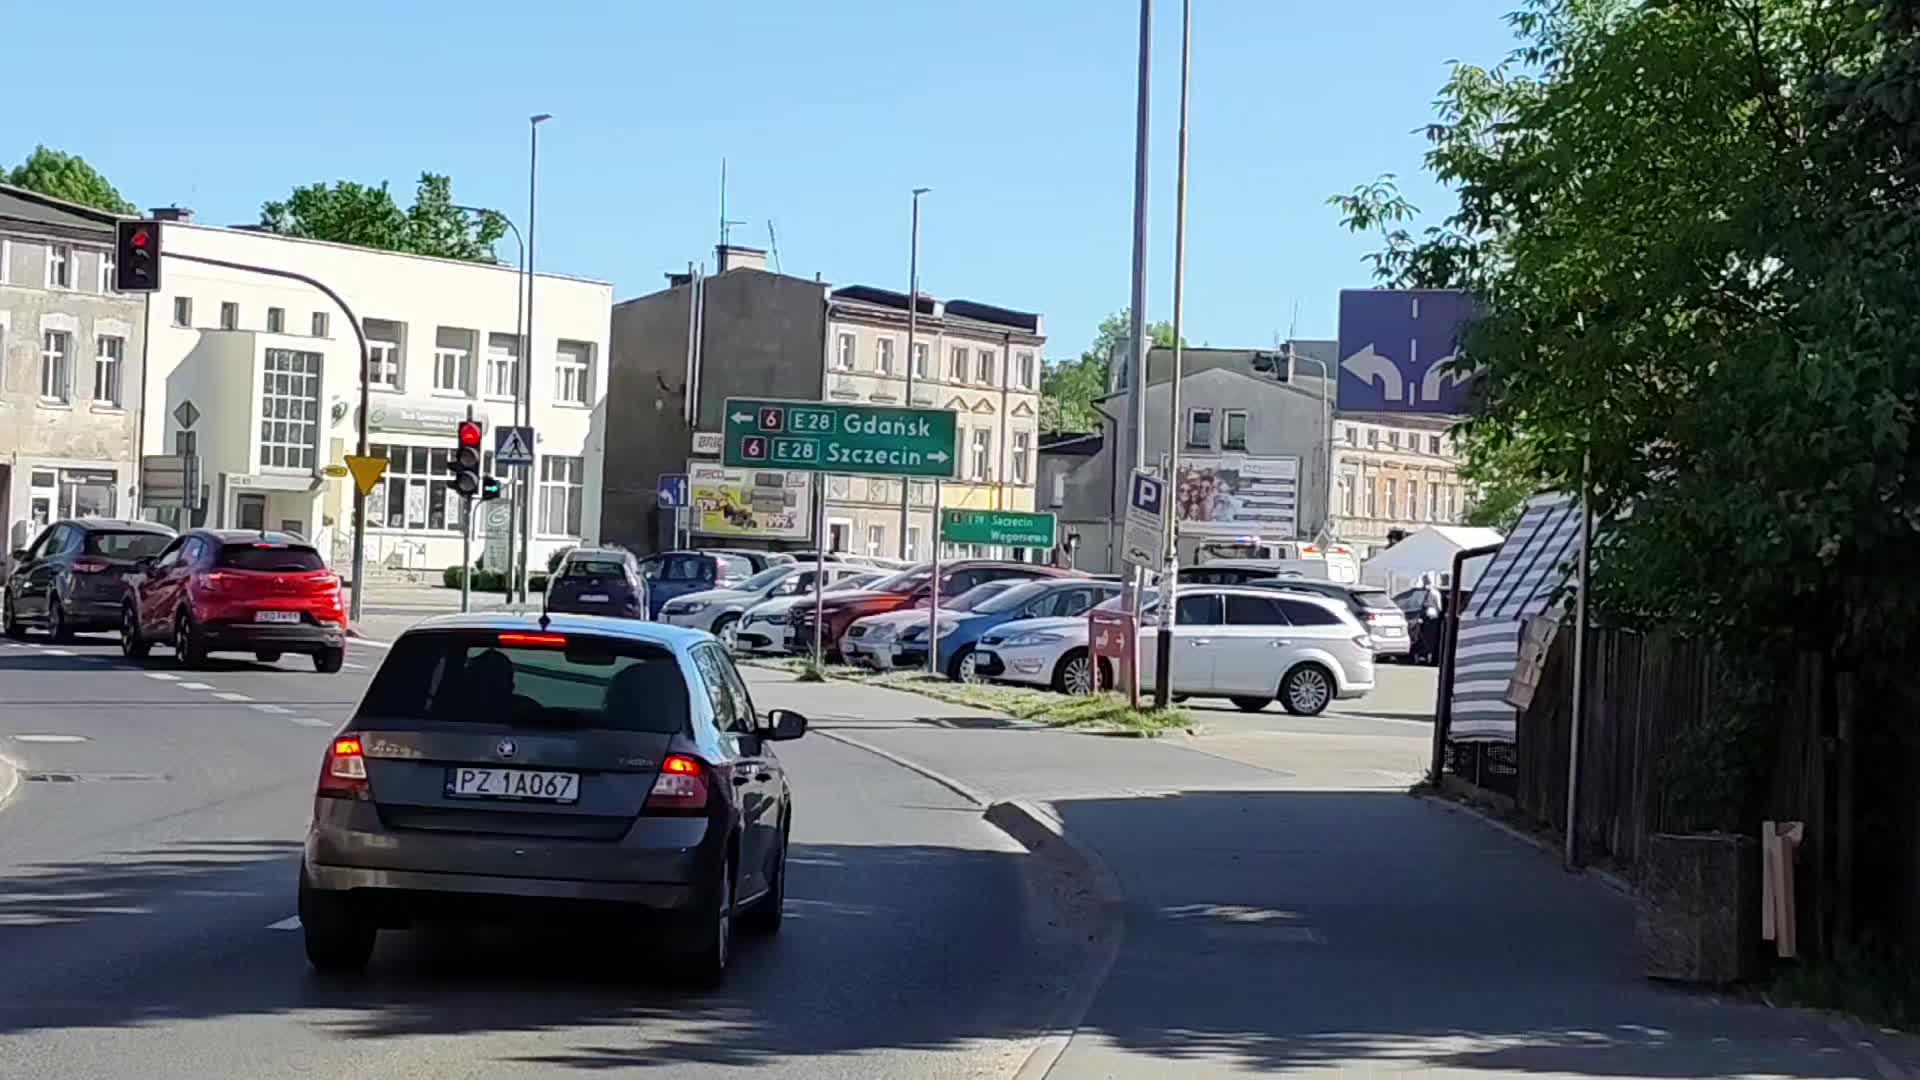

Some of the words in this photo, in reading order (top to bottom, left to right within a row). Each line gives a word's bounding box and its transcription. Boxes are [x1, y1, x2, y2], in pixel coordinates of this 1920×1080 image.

[766, 409, 777, 427] 6
[843, 413, 931, 437] Gdańsk
[749, 438, 760, 456] 6
[826, 443, 922, 465] Szczecin
[1138, 479, 1157, 506] P
[992, 514, 1034, 527] Szczecin
[460, 770, 492, 793] PZ
[502, 773, 573, 797] 1A067
